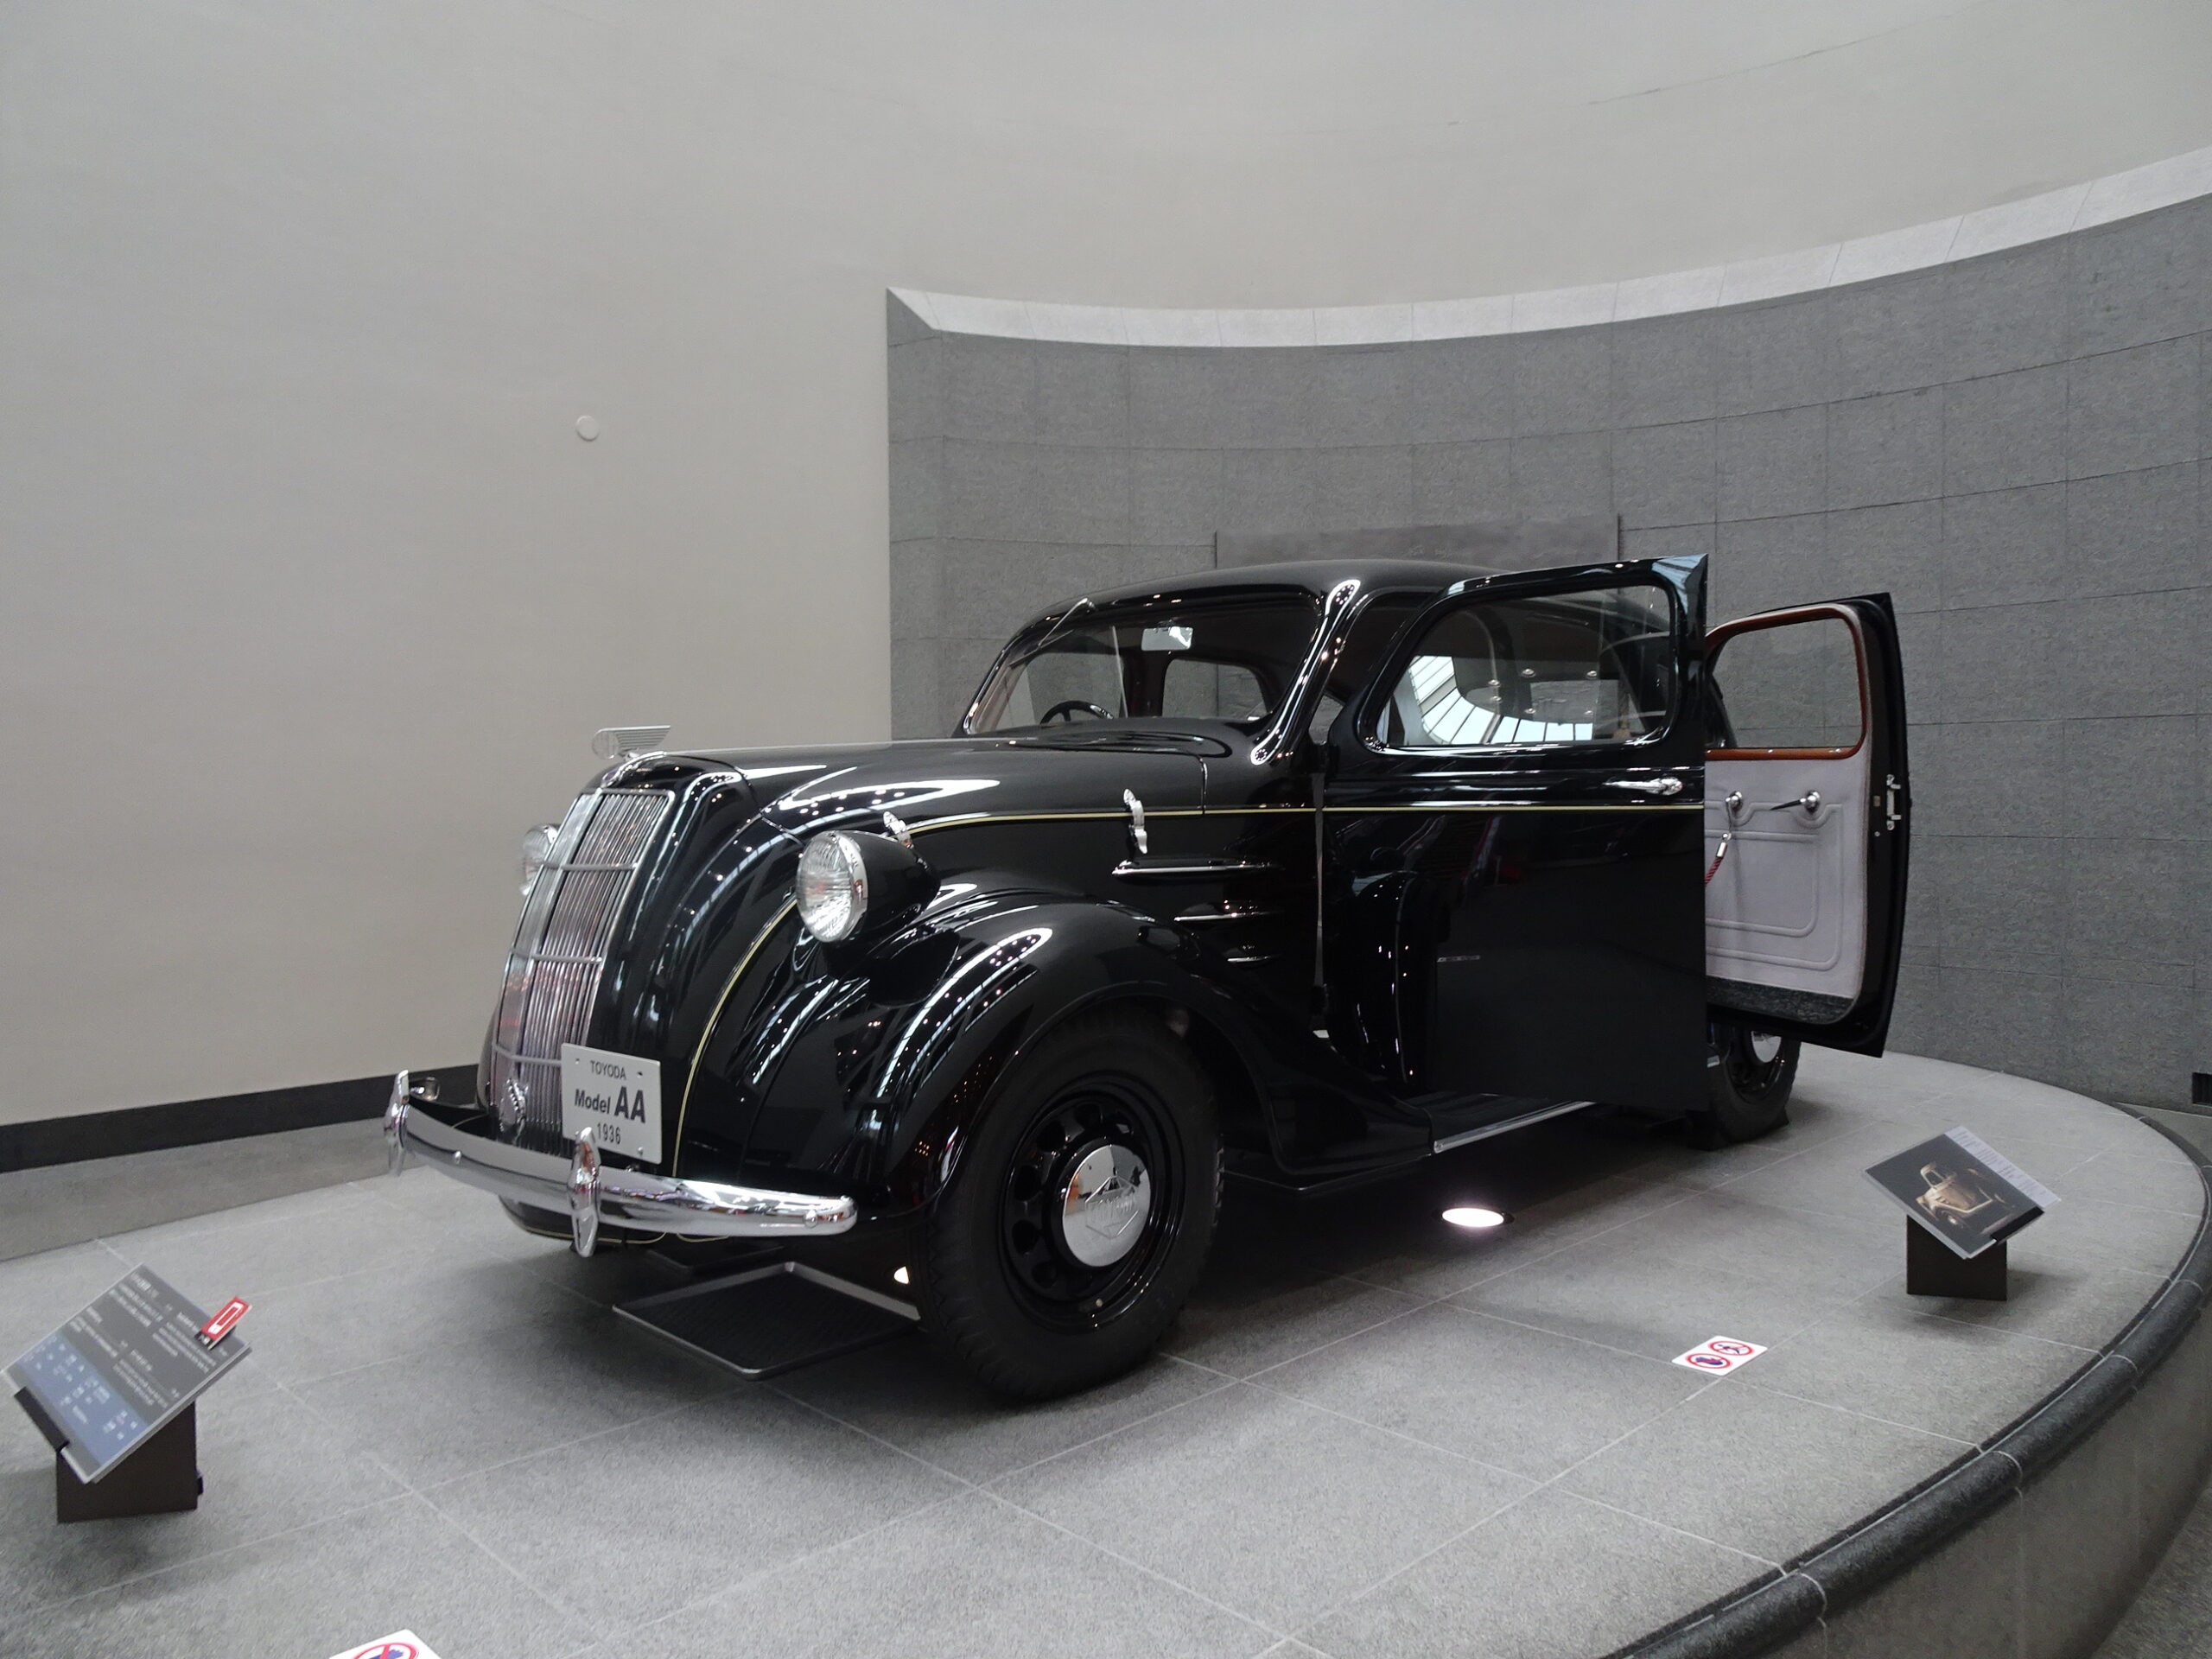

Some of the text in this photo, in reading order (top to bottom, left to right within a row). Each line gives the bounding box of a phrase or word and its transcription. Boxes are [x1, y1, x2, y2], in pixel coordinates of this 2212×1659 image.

[591, 1061, 626, 1080] TOYODA
[575, 1086, 645, 1123] Model AA
[598, 1123, 621, 1145] 1936
